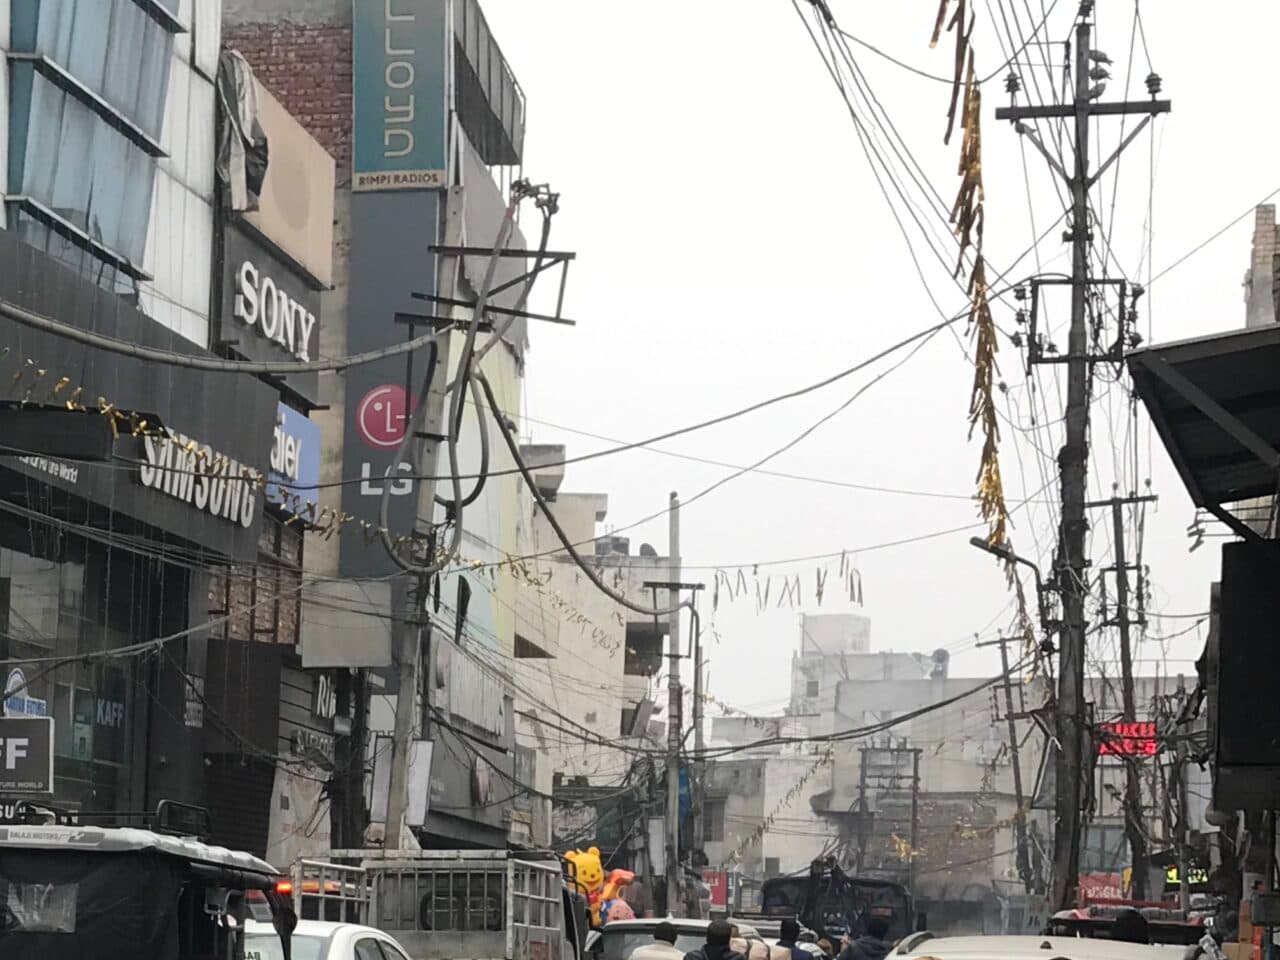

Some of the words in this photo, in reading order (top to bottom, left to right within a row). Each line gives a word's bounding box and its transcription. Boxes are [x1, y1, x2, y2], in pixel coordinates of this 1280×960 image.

[358, 175, 391, 186] RIMPI
[393, 173, 439, 184] RADIOS
[234, 260, 316, 363] SONY
[270, 412, 302, 481] aier
[140, 426, 258, 528] SAMSUNG
[360, 461, 414, 495] LG
[95, 697, 125, 730] KAFF
[17, 781, 44, 789] WORLD
